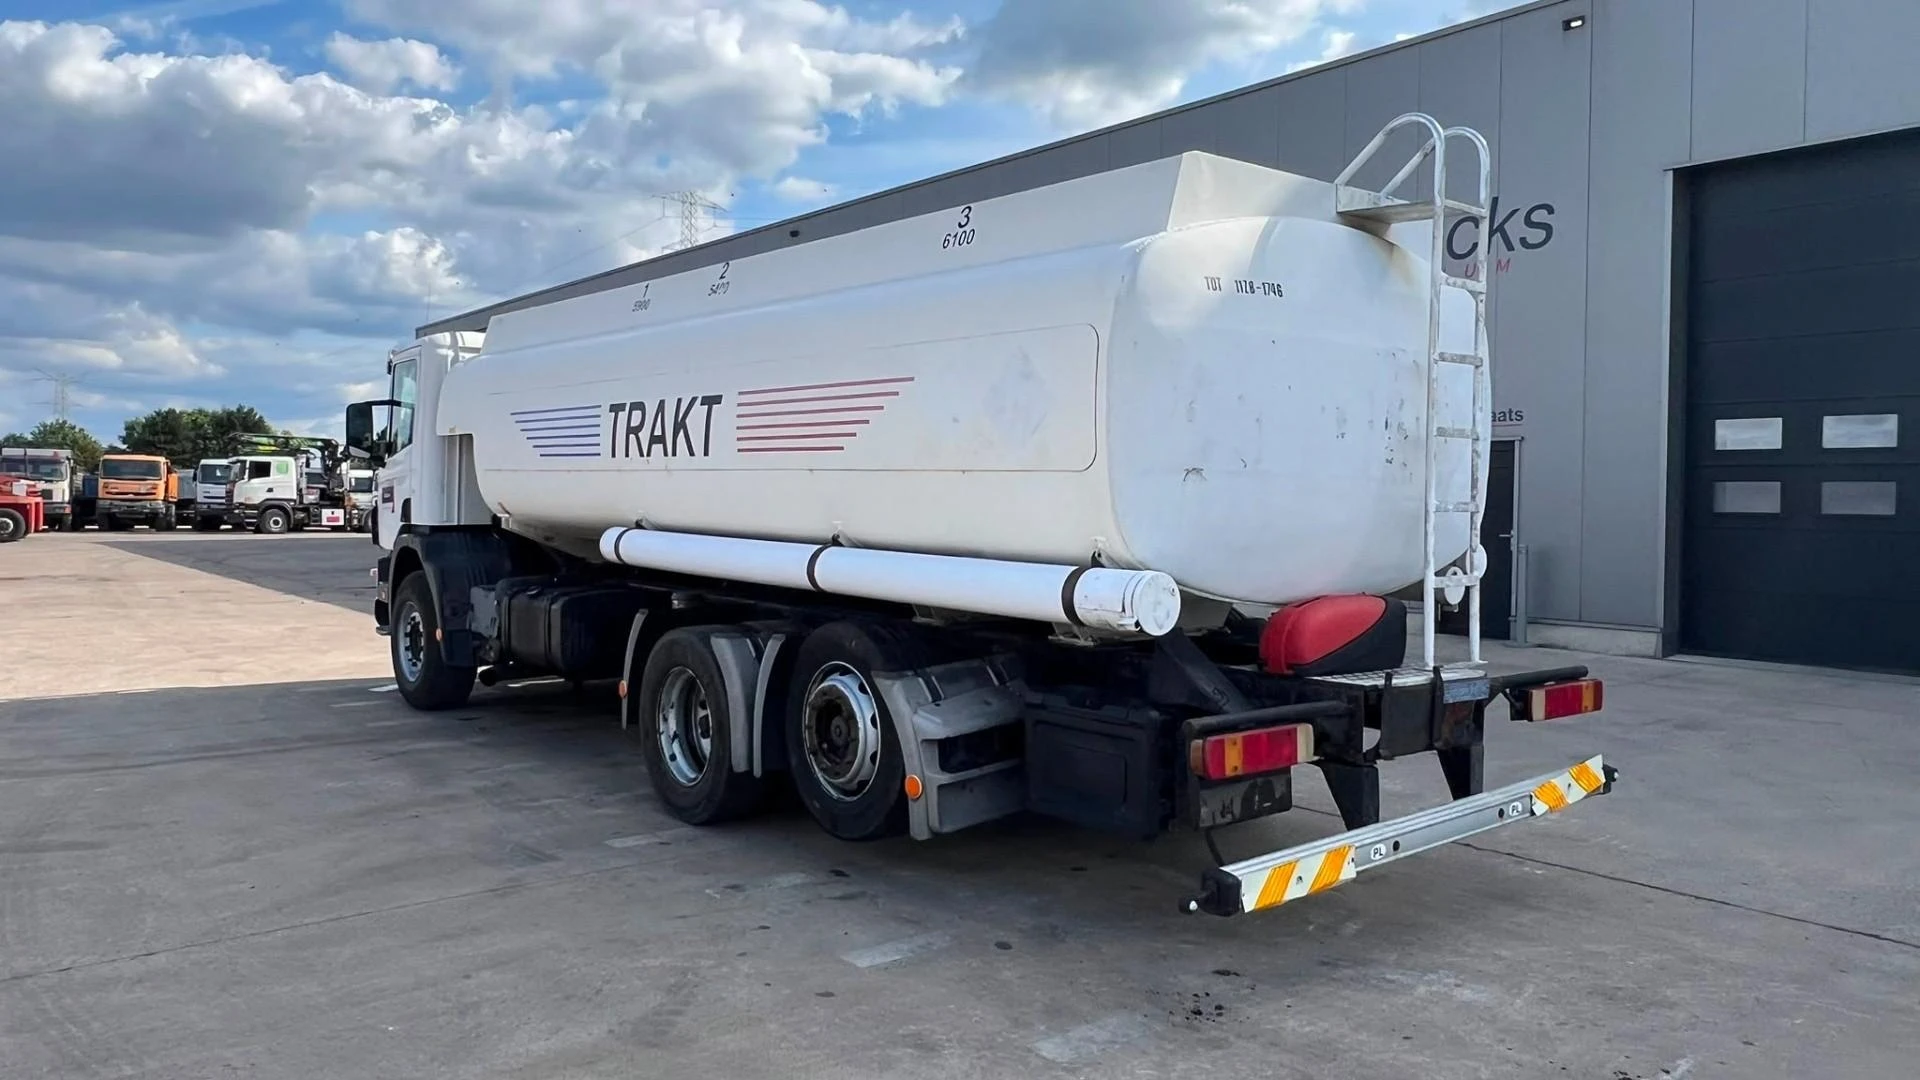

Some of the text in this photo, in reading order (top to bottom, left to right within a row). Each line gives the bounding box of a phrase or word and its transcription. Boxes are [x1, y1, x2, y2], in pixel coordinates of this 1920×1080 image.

[958, 205, 972, 229] 3
[942, 228, 976, 249] 6100
[718, 261, 730, 280] 2
[643, 282, 650, 298] 1
[608, 394, 723, 459] TRAKT
[1511, 803, 1521, 815] PL
[1372, 846, 1384, 858] PL
